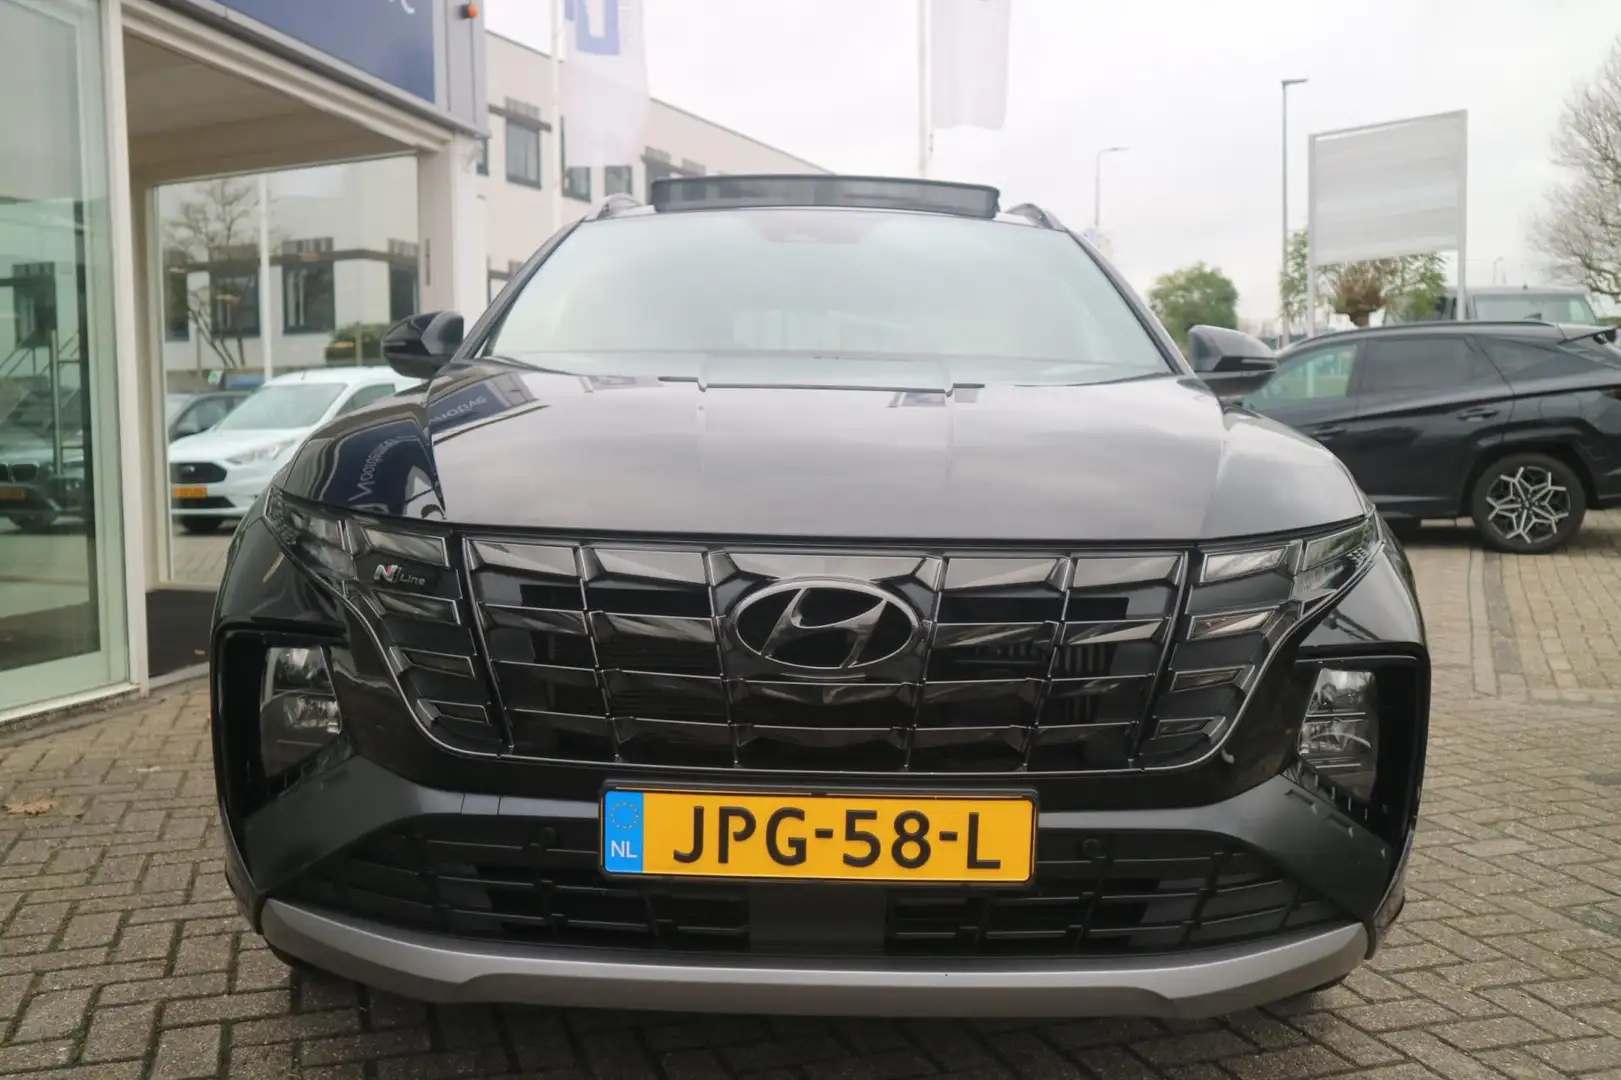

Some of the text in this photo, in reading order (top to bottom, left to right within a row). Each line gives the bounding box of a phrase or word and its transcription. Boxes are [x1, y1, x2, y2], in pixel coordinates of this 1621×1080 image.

[399, 573, 425, 586] Line
[672, 805, 1002, 870] JPG-58-L
[610, 839, 637, 859] NL
